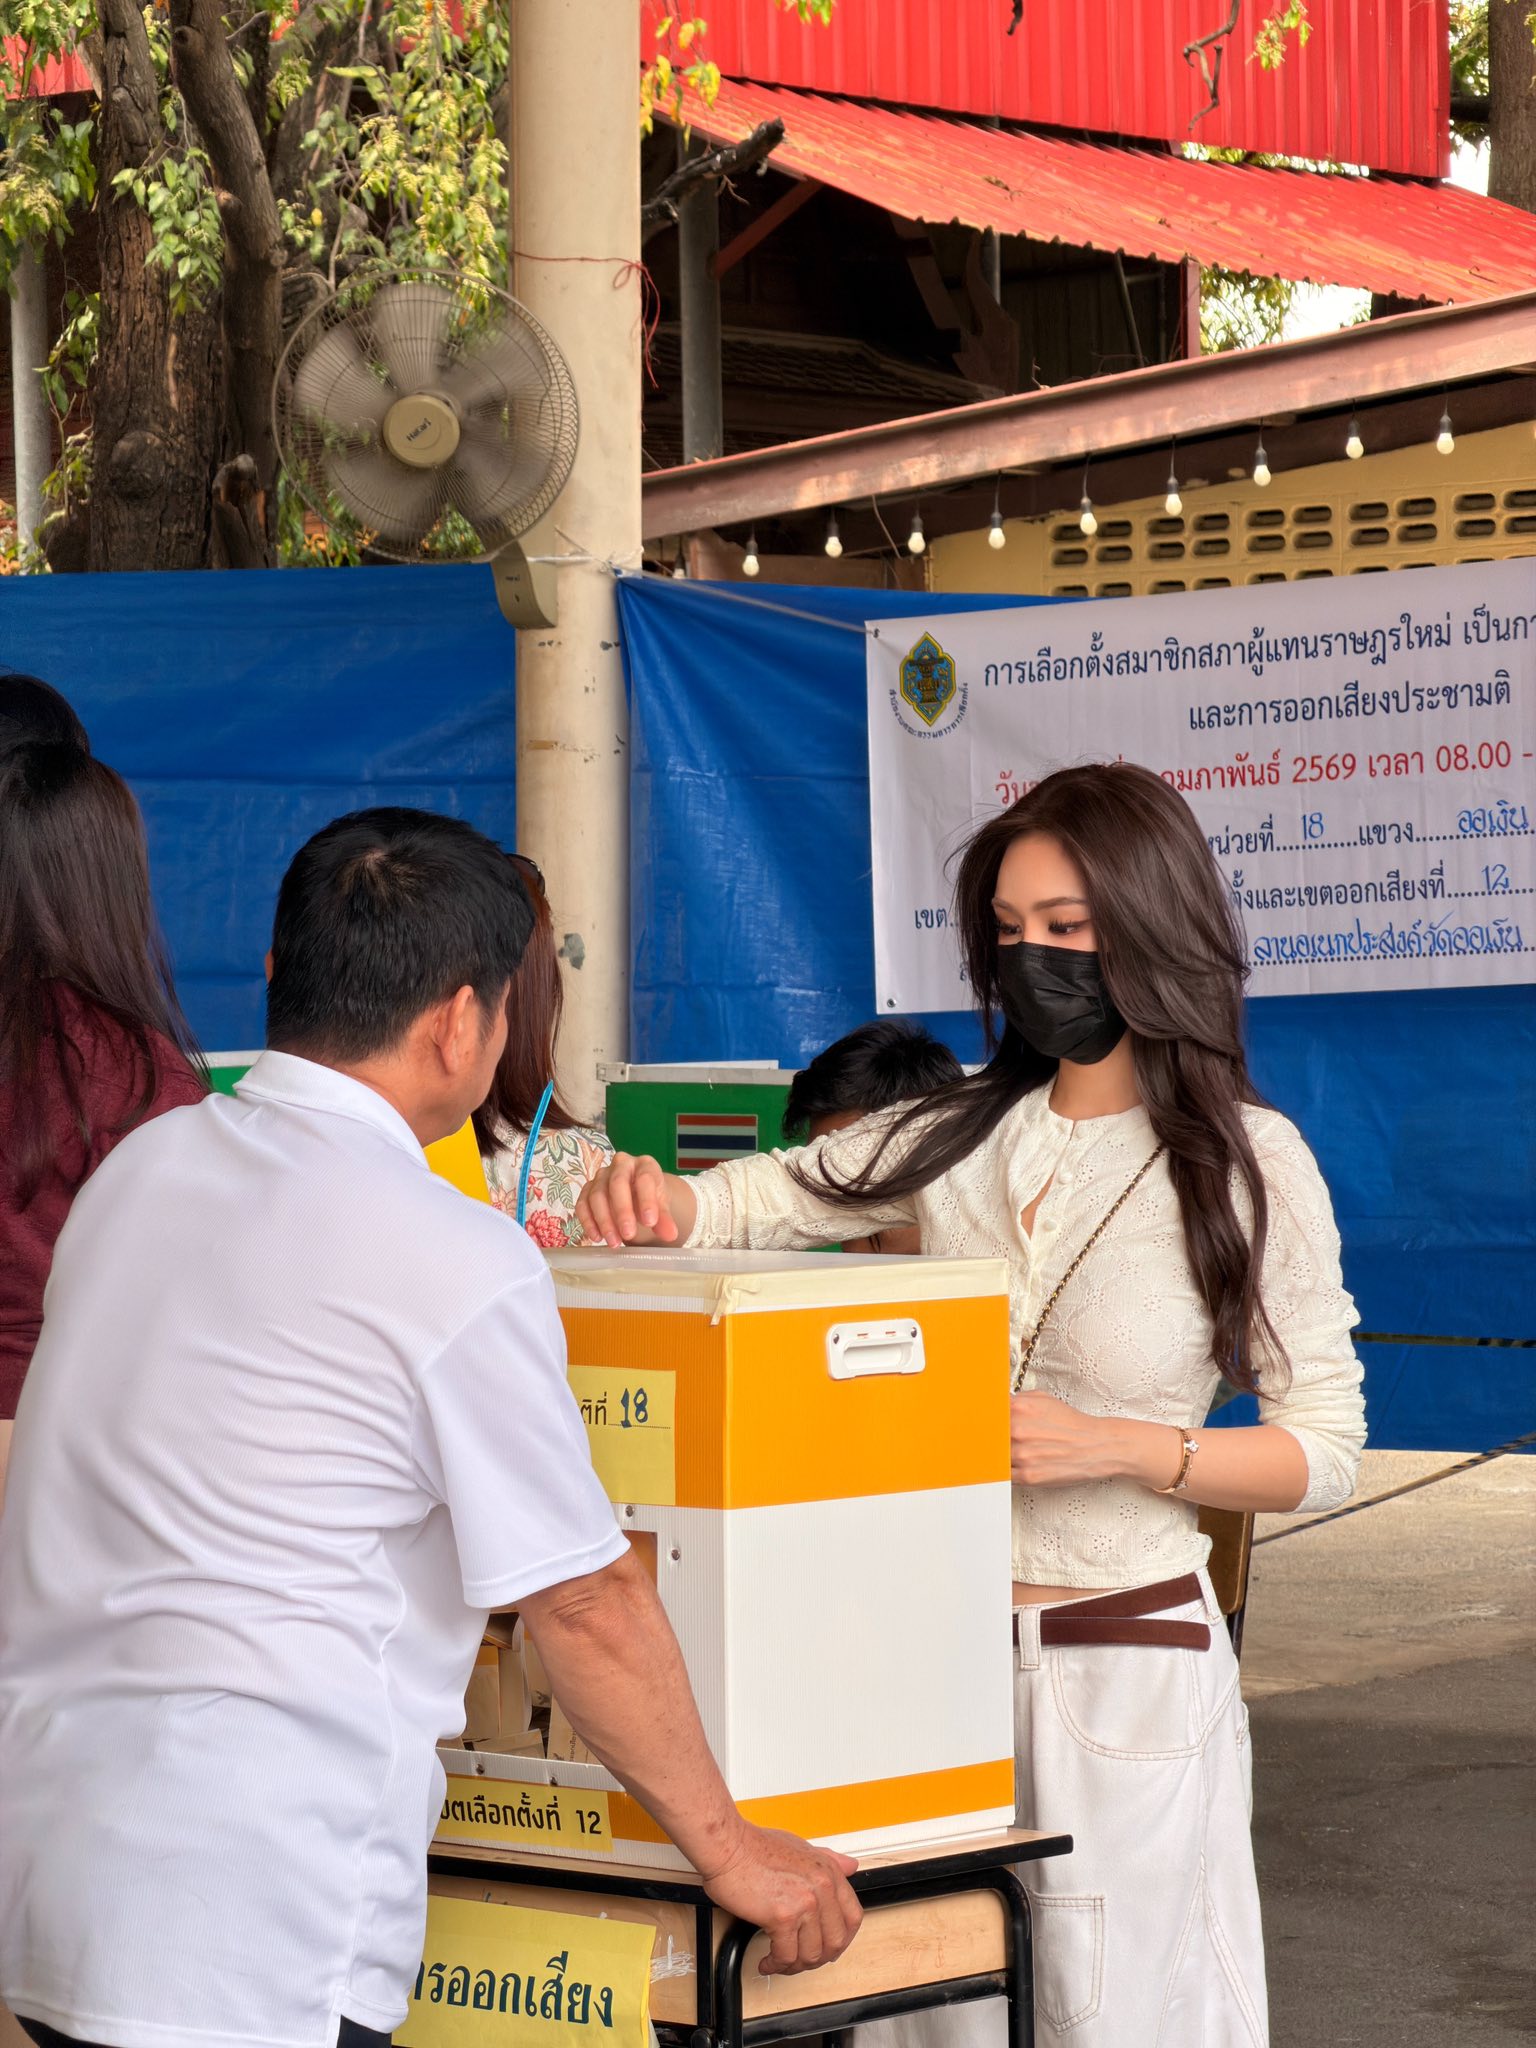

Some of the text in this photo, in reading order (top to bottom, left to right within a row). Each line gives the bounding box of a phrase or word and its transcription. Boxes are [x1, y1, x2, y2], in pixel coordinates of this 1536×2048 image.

[984, 611, 1451, 687] การเลือกตั้งสมาชิกสภาผู้แทนราษฎรใหม่
[1189, 669, 1511, 731] และการออกเสียงประชามติ
[1292, 753, 1356, 783] 2569
[1369, 751, 1423, 777] เวลา
[1436, 741, 1511, 773] 08.00
[1302, 812, 1324, 841] 18
[1481, 863, 1509, 891] 12
[621, 1388, 648, 1428] 18
[576, 1809, 602, 1834] 12
